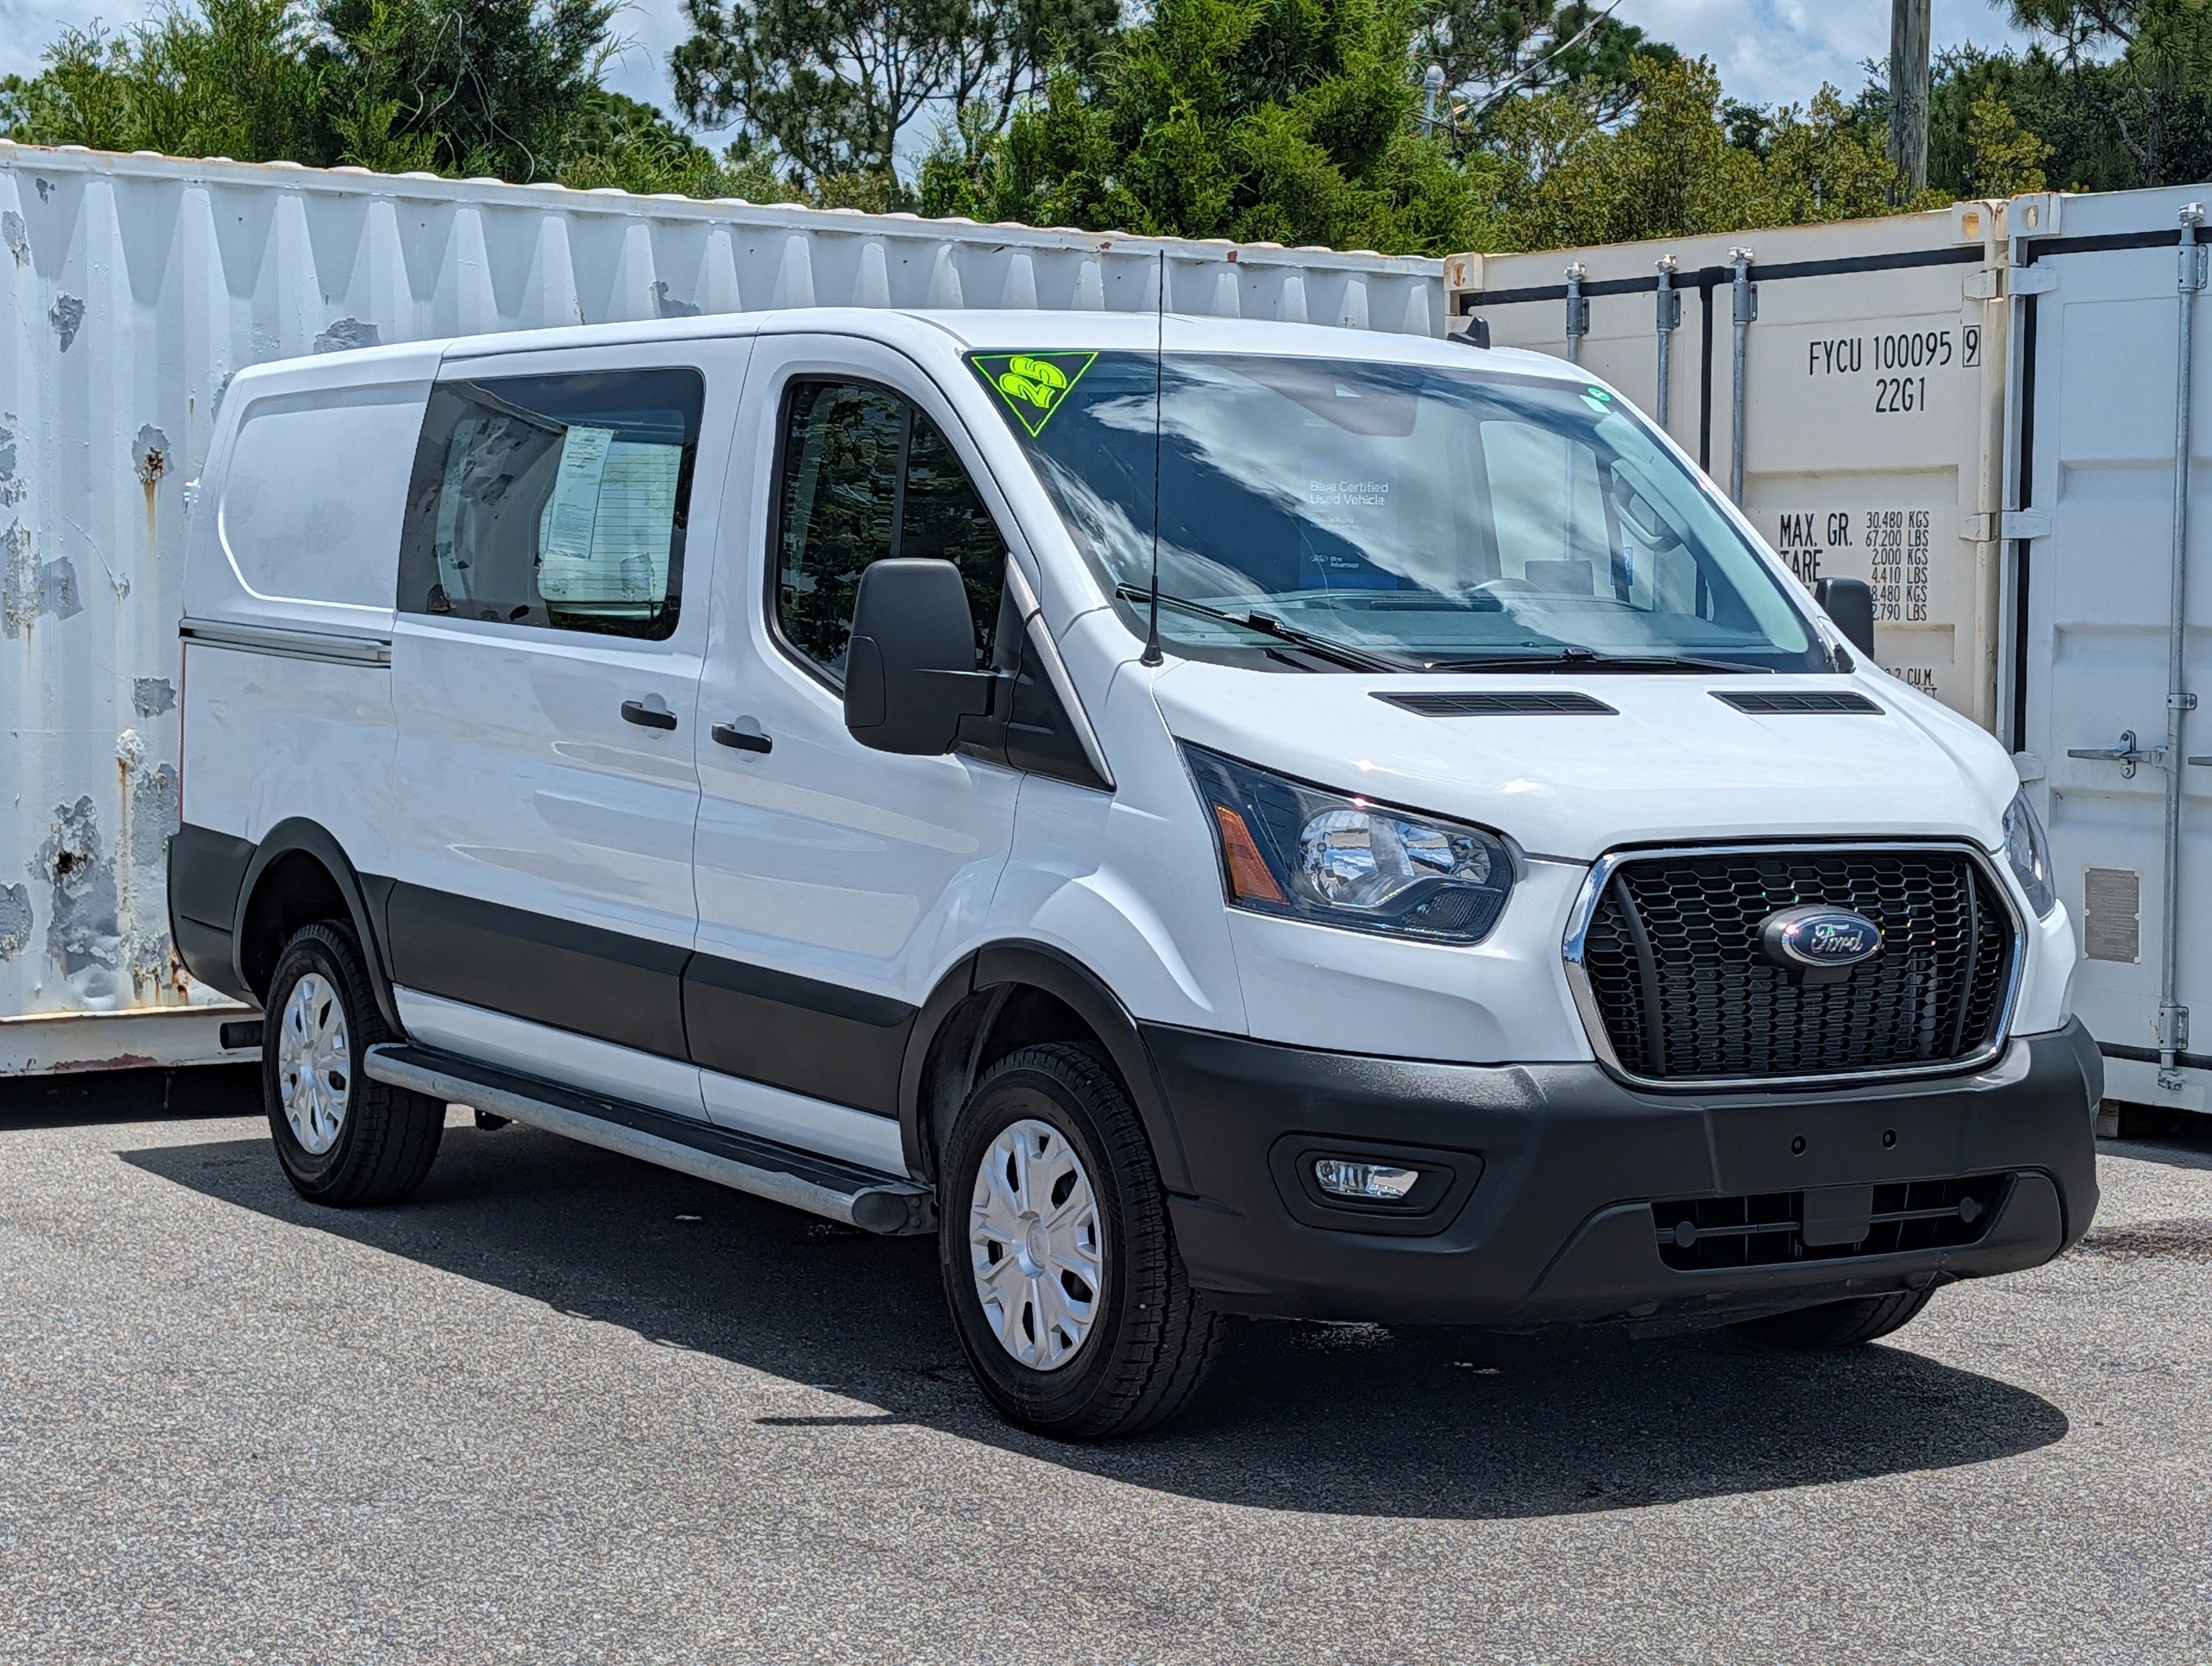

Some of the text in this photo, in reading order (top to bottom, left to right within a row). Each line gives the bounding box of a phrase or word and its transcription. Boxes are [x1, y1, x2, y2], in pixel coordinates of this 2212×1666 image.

[1809, 328, 1979, 375] FYCU 100095 9
[1875, 377, 1925, 413] 22G1
[1310, 480, 1389, 492] Blue Certified
[1310, 494, 1385, 505] Used Vehicle
[1866, 511, 1930, 529] 30.480 KGS
[1780, 512, 1853, 547] MAX. GR.
[1908, 529, 1928, 547] LBS
[1780, 549, 1823, 582] TARE
[1907, 548, 1928, 566] KGS
[1907, 566, 1928, 585] LBS
[1870, 585, 1927, 603] 8.480 KGS
[1906, 603, 1927, 621] LBS
[1811, 924, 1863, 953] Ford
